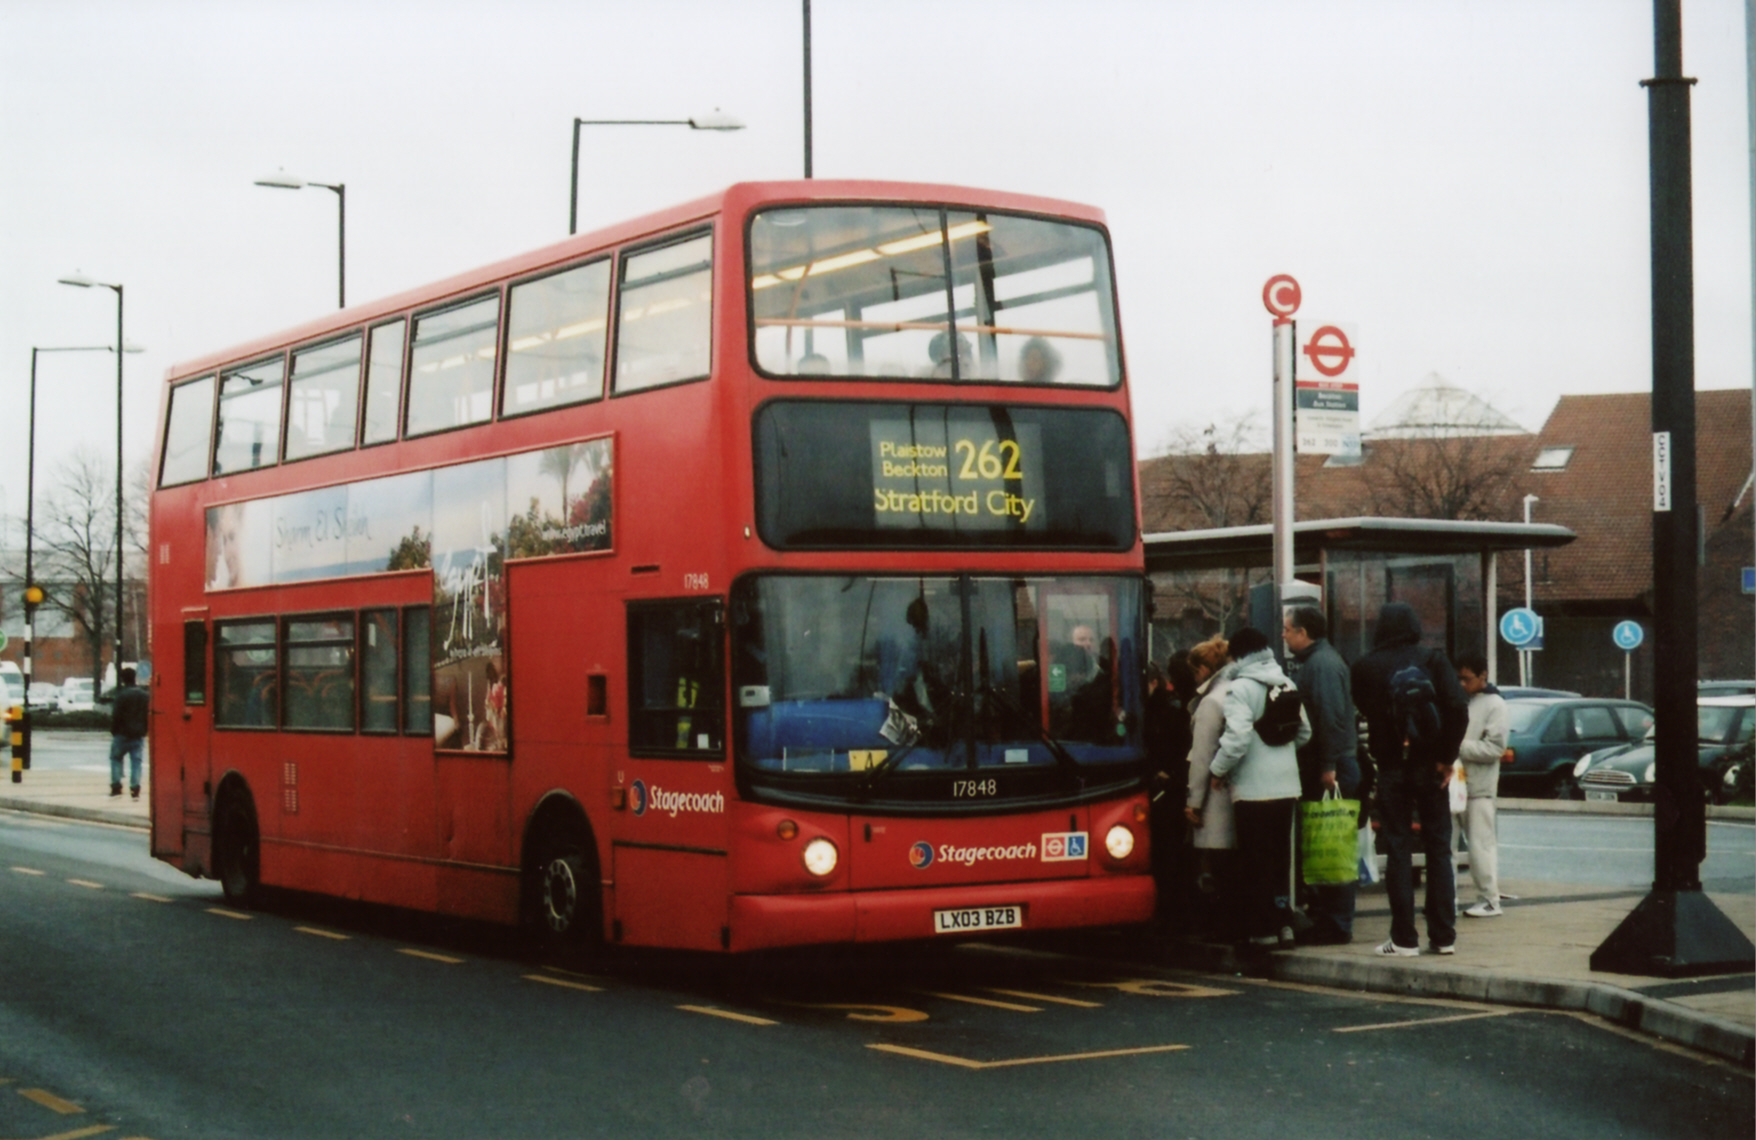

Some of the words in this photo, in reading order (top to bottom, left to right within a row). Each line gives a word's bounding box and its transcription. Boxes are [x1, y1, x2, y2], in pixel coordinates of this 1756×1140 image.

[1269, 280, 1294, 312] C
[880, 441, 947, 458] Plaistow
[955, 439, 1023, 480] 262
[882, 460, 948, 477] Beckton
[874, 488, 978, 515] Stratford
[986, 490, 1035, 524] City
[684, 572, 709, 590] 17848
[953, 778, 997, 797] 17848
[649, 785, 725, 818] Stagecoach
[937, 842, 1037, 867] Stagecoach
[940, 910, 981, 930] LX03
[985, 908, 1016, 926] BZB
